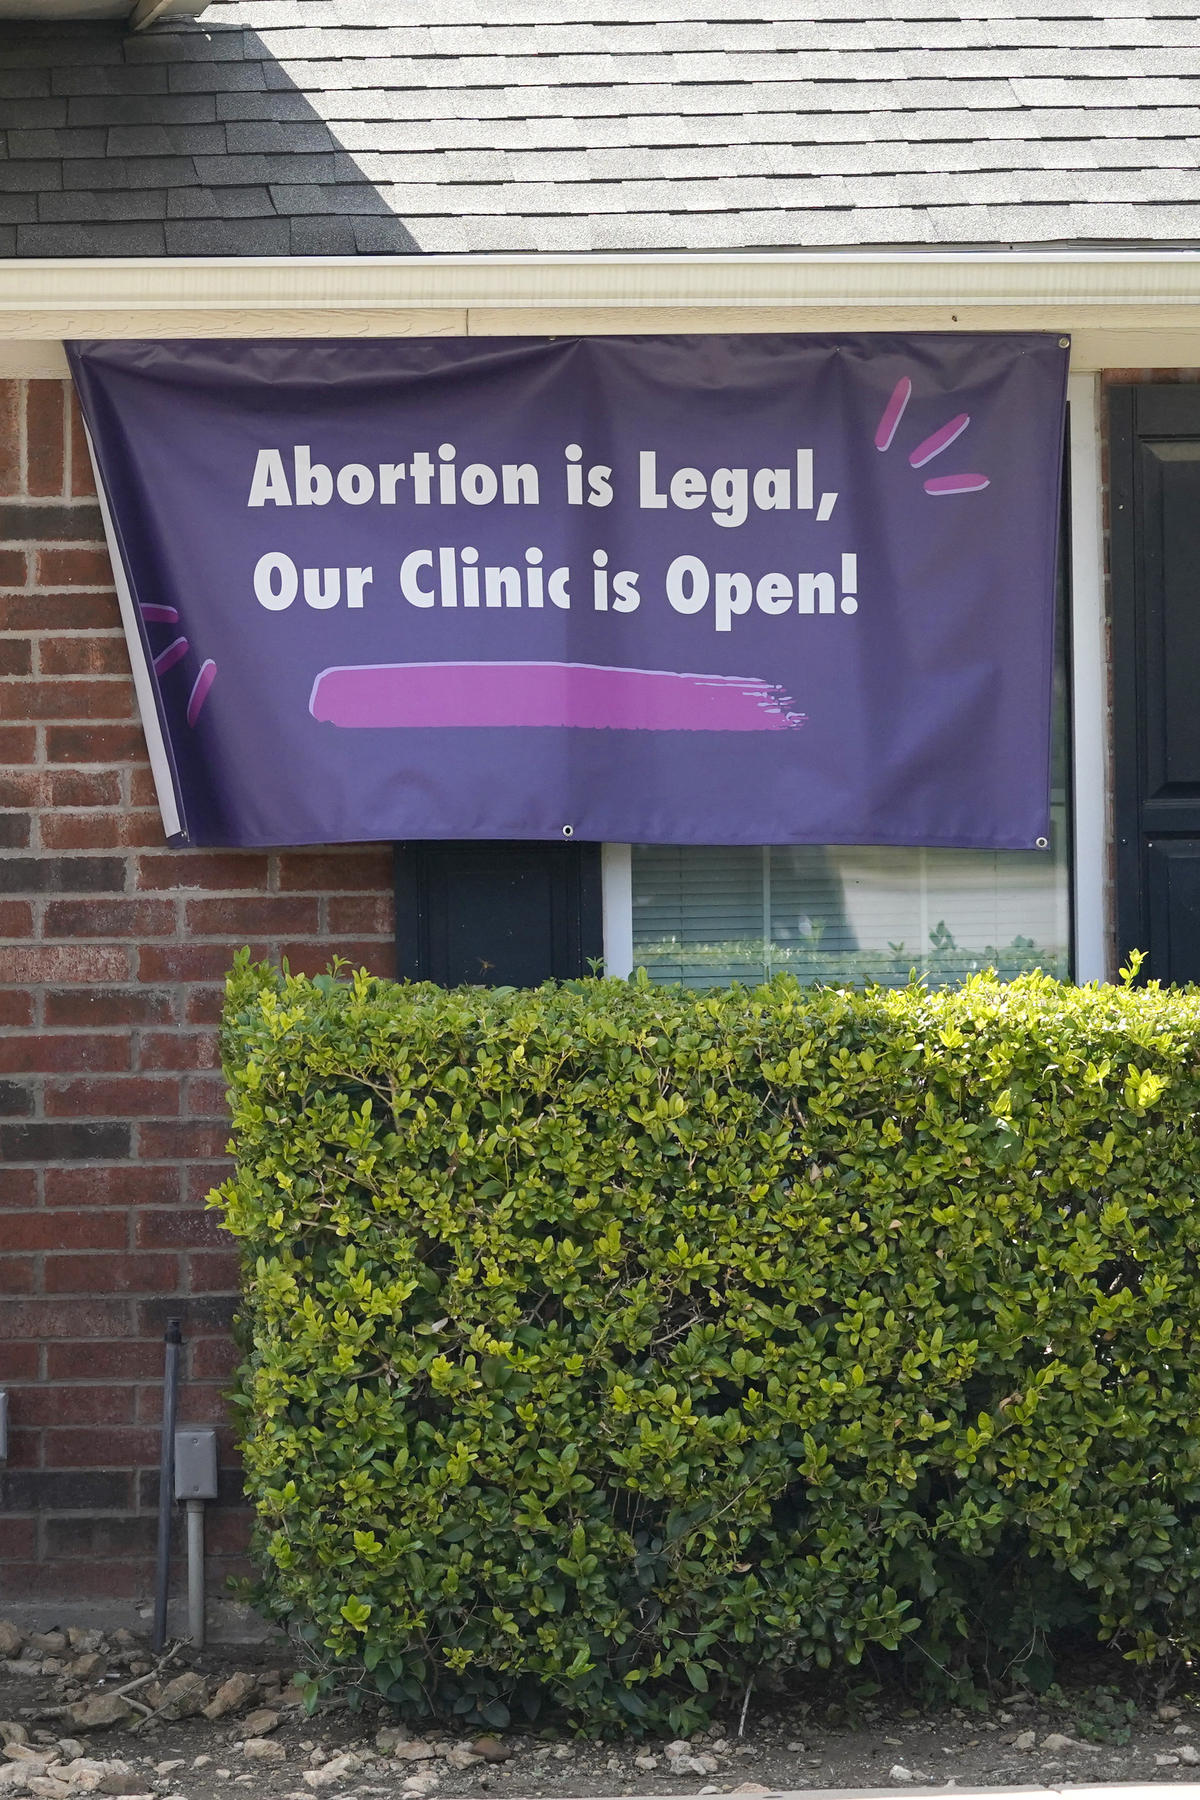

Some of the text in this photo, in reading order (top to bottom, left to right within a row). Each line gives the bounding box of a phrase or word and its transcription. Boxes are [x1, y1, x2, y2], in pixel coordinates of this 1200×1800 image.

[248, 444, 838, 527] Abortion is Legal,
[254, 547, 857, 631] Our Clinic is Open!
